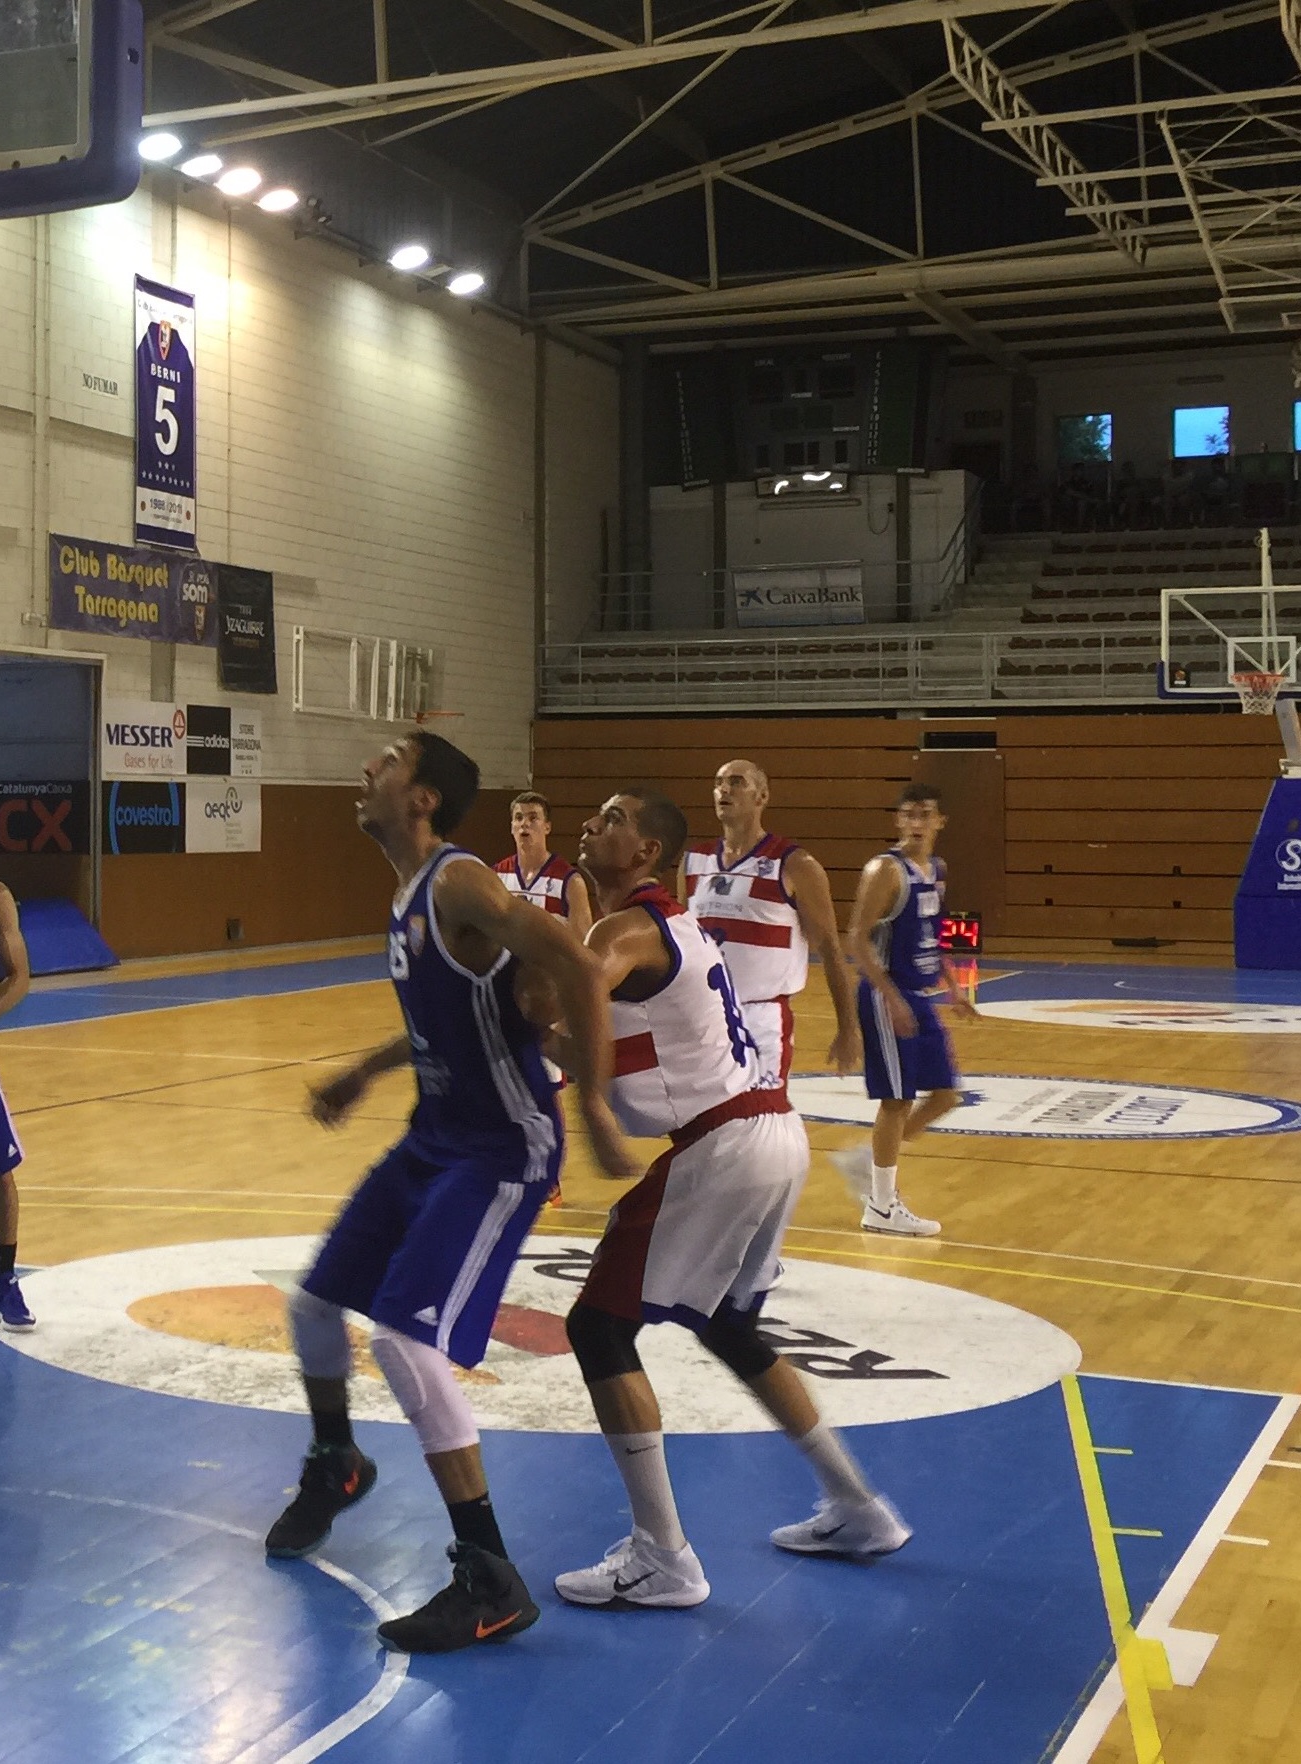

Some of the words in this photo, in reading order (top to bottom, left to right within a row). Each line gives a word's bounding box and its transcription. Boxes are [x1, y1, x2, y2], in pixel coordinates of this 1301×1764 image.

[150, 363, 181, 383] BERNI
[155, 385, 179, 455] 5
[59, 545, 100, 578] Club
[74, 585, 159, 628] Tarragona
[766, 587, 861, 605] CaixaBank
[204, 734, 230, 749] adidas
[124, 752, 146, 768] Gases
[115, 804, 173, 827] covestro
[939, 919, 979, 949] 24
